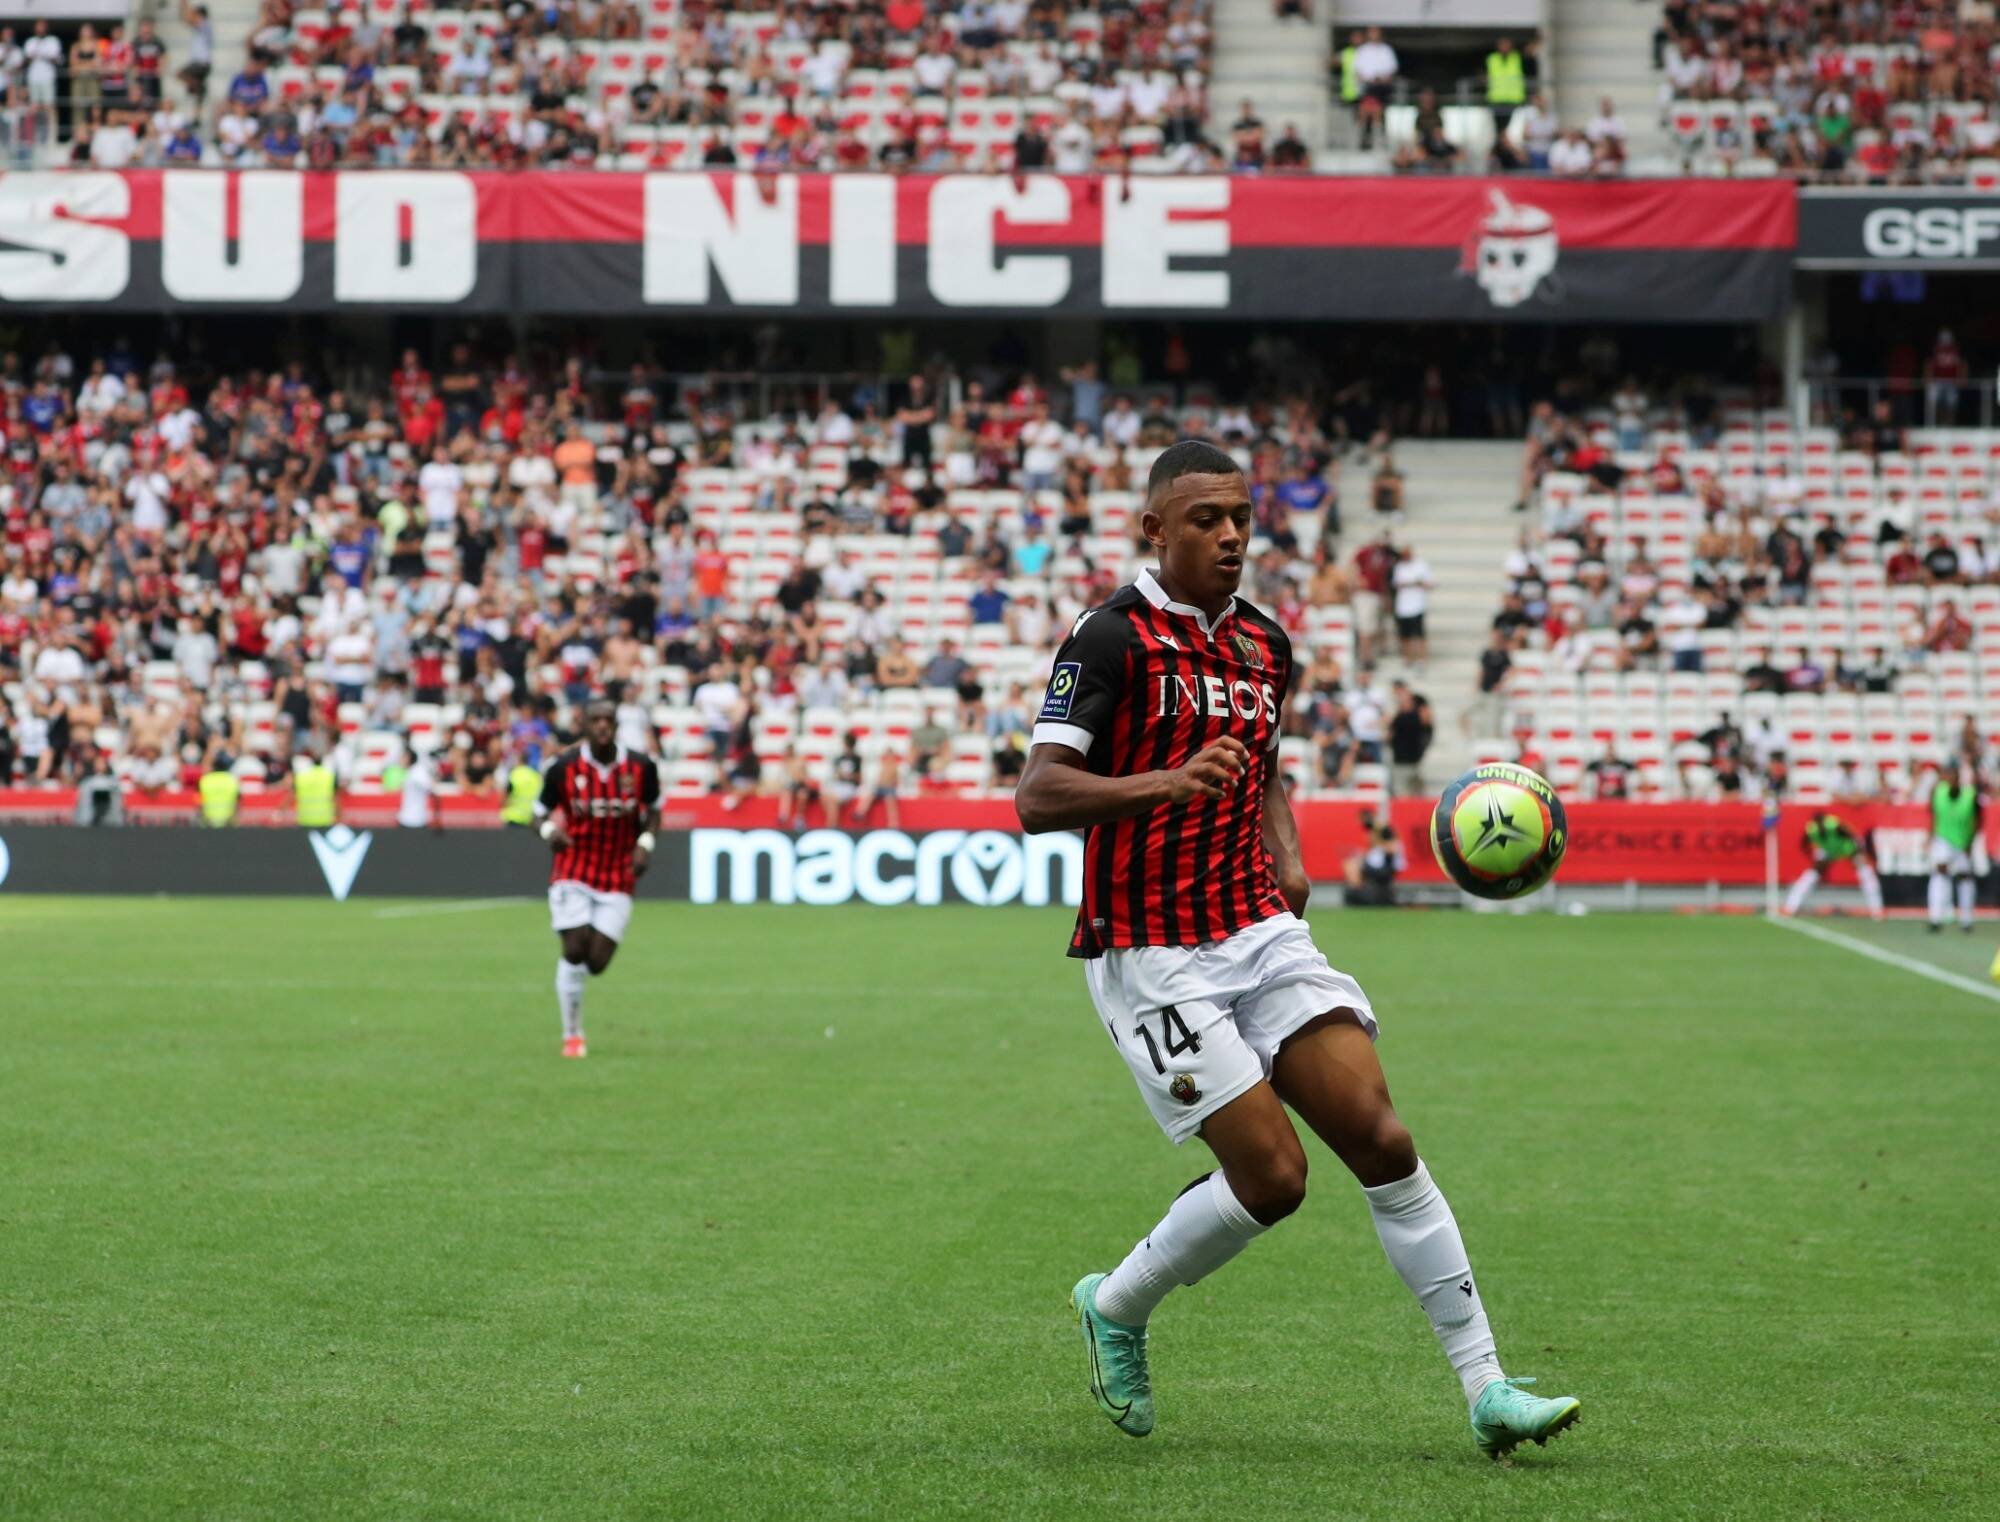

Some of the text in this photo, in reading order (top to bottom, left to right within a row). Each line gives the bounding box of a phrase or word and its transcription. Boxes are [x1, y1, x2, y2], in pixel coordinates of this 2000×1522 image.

[0, 171, 1230, 307] SUD NICE
[1863, 207, 2000, 257] GSF
[1046, 698, 1062, 706] LIGUE
[1157, 675, 1276, 723] INEOS
[1476, 767, 1553, 804] uhlsport
[690, 828, 1084, 905] macron
[1133, 1004, 1201, 1075] 14
